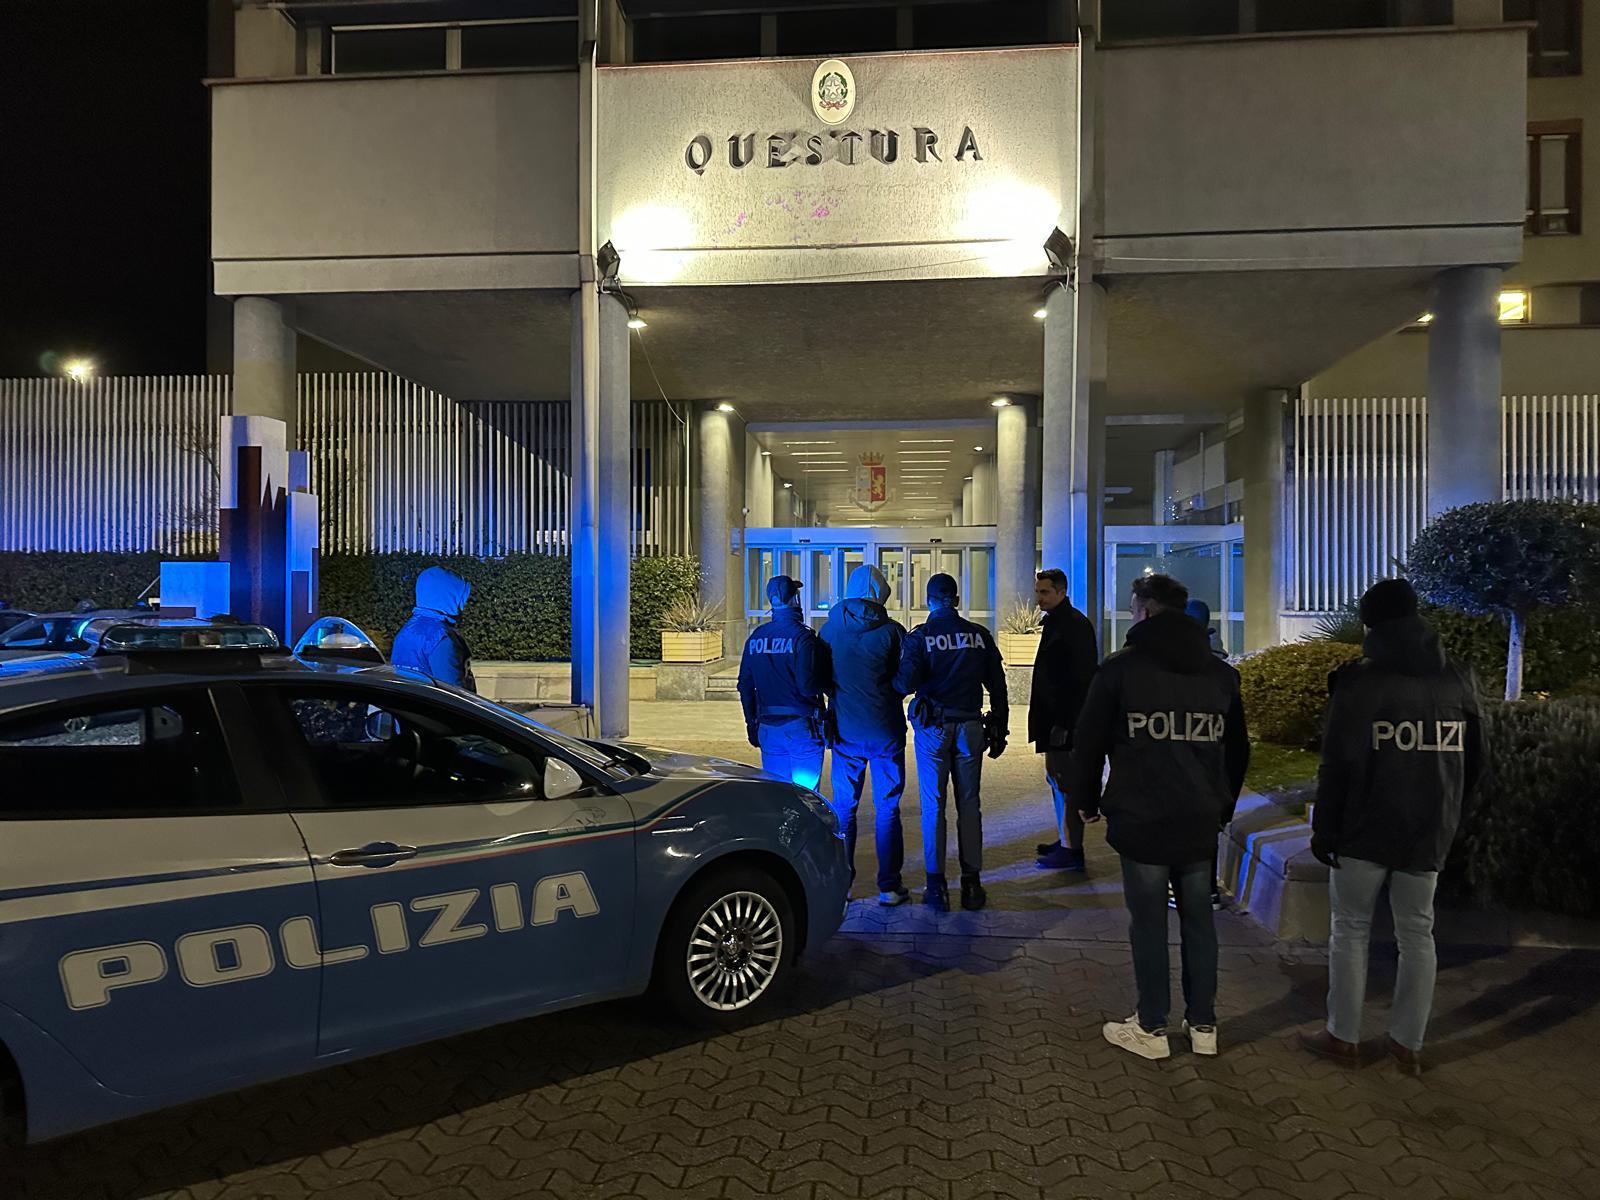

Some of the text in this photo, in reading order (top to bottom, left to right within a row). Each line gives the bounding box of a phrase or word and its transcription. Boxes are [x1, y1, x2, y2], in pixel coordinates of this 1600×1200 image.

[685, 126, 983, 176] QUESTURA
[749, 637, 794, 655] POLIZIA
[925, 632, 986, 652] POLIZIA
[1372, 720, 1467, 752] POLIZI
[58, 870, 600, 1012] POLIZIA
